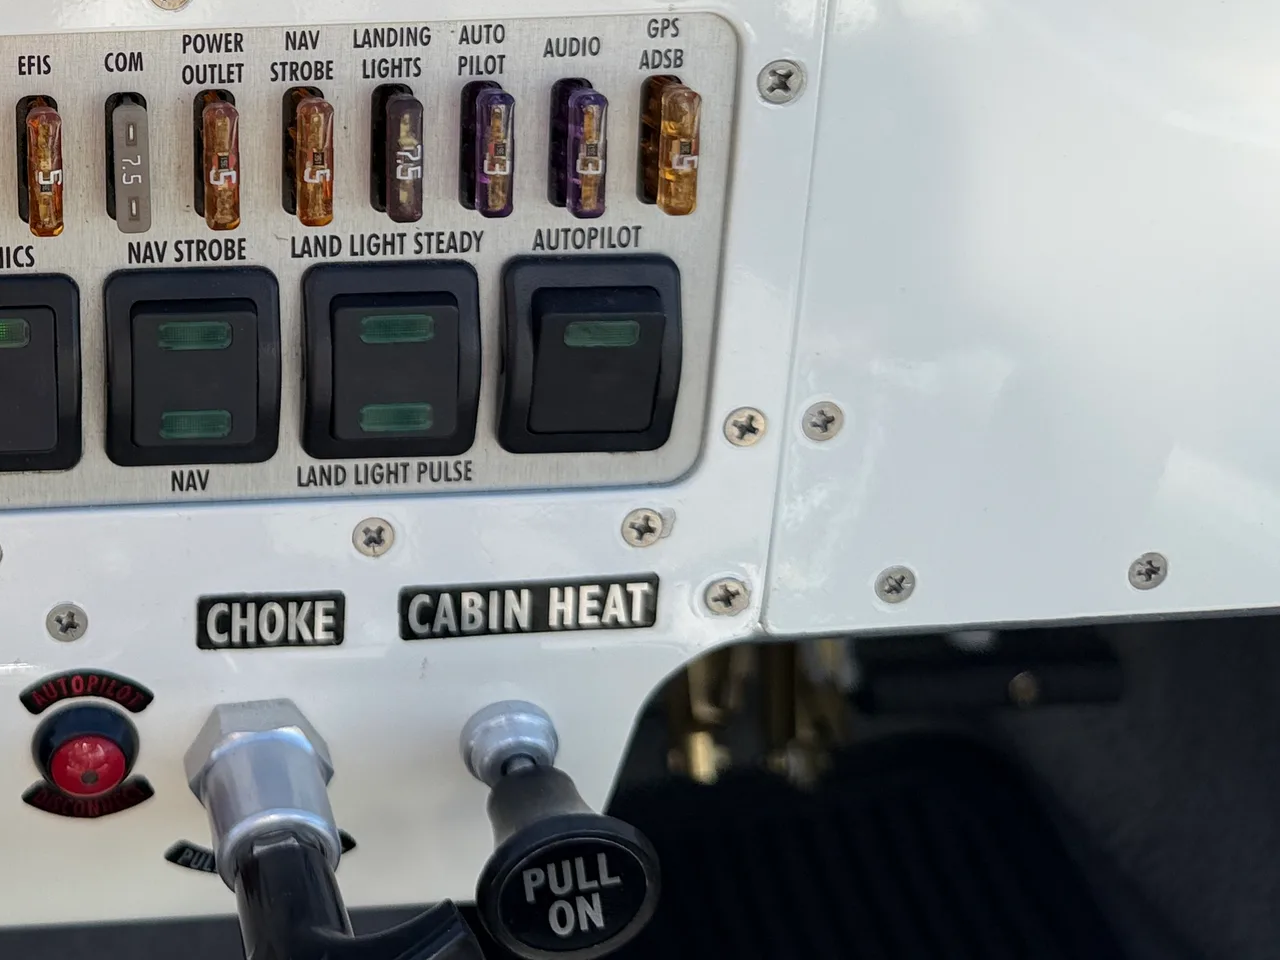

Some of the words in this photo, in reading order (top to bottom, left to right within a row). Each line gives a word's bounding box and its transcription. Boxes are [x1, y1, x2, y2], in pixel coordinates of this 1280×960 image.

[353, 26, 432, 49] LANDING
[458, 23, 506, 45] AUTO
[647, 18, 680, 38] GPS
[182, 32, 244, 54] POWER
[285, 30, 320, 51] NAV
[543, 36, 601, 58] AUDIO
[18, 55, 52, 76] EFIS
[104, 51, 144, 72] COM
[362, 57, 422, 79] LIGHTS
[458, 54, 506, 76] PILOT
[639, 48, 684, 70] ADSB
[182, 62, 244, 85] OUTLET
[270, 60, 334, 82] STROBE
[122, 155, 142, 185] 7.5
[291, 235, 342, 258] LAND
[349, 233, 407, 256] LIGHT
[413, 230, 484, 254] STEADY
[532, 225, 642, 251] AUTOPILOT
[128, 241, 167, 263] NAV
[173, 238, 246, 262] STROBE
[170, 470, 209, 492] NAV
[296, 465, 346, 487] LAND
[353, 462, 410, 485] LIGHT
[417, 460, 473, 482] PULSE
[408, 587, 532, 634] CABIN
[548, 582, 650, 627] HEAT
[206, 600, 337, 644] CHOKE
[32, 675, 144, 705] AUTOPILOT
[177, 848, 219, 873] PUL
[523, 853, 621, 903] PULL
[548, 893, 603, 936] ON
